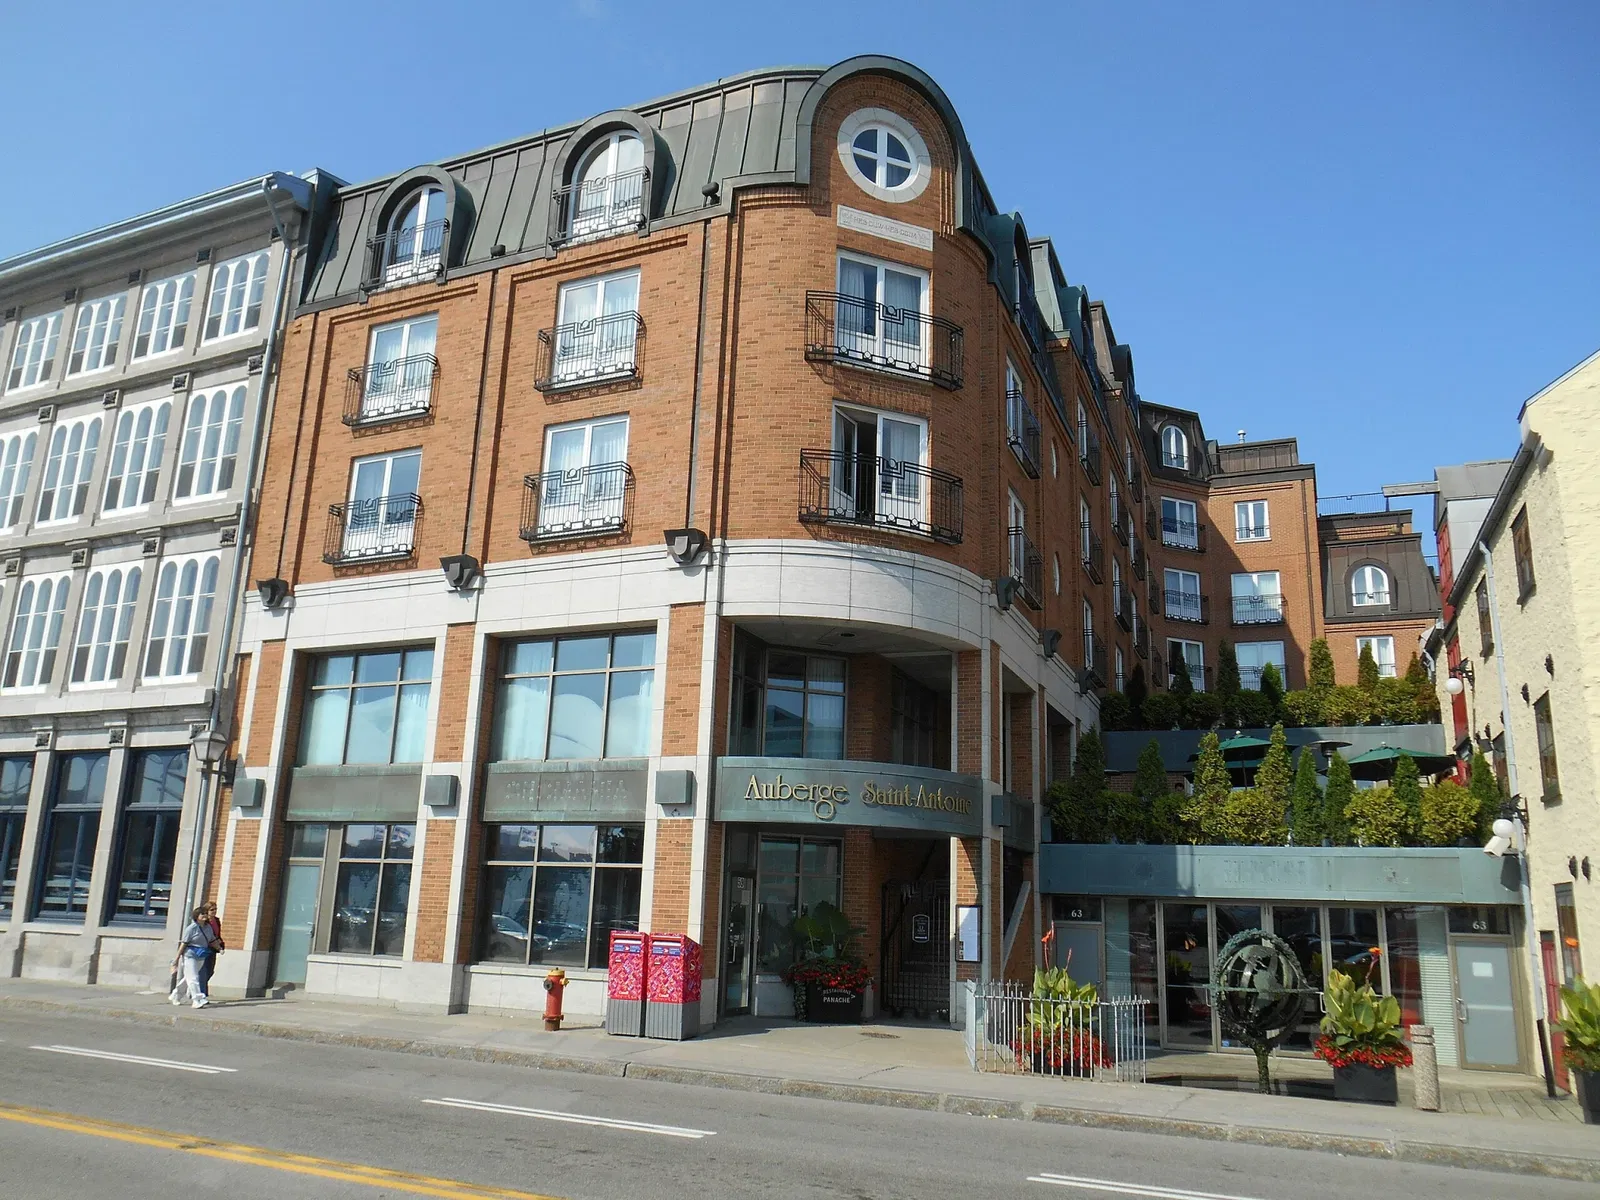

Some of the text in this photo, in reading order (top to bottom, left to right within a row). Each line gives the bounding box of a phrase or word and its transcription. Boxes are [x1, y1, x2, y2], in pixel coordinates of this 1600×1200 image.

[744, 775, 972, 819] Auberge Saint-Antoine
[1071, 909, 1083, 918] 63
[1472, 920, 1487, 930] 63
[823, 996, 850, 1004] PANACHE
